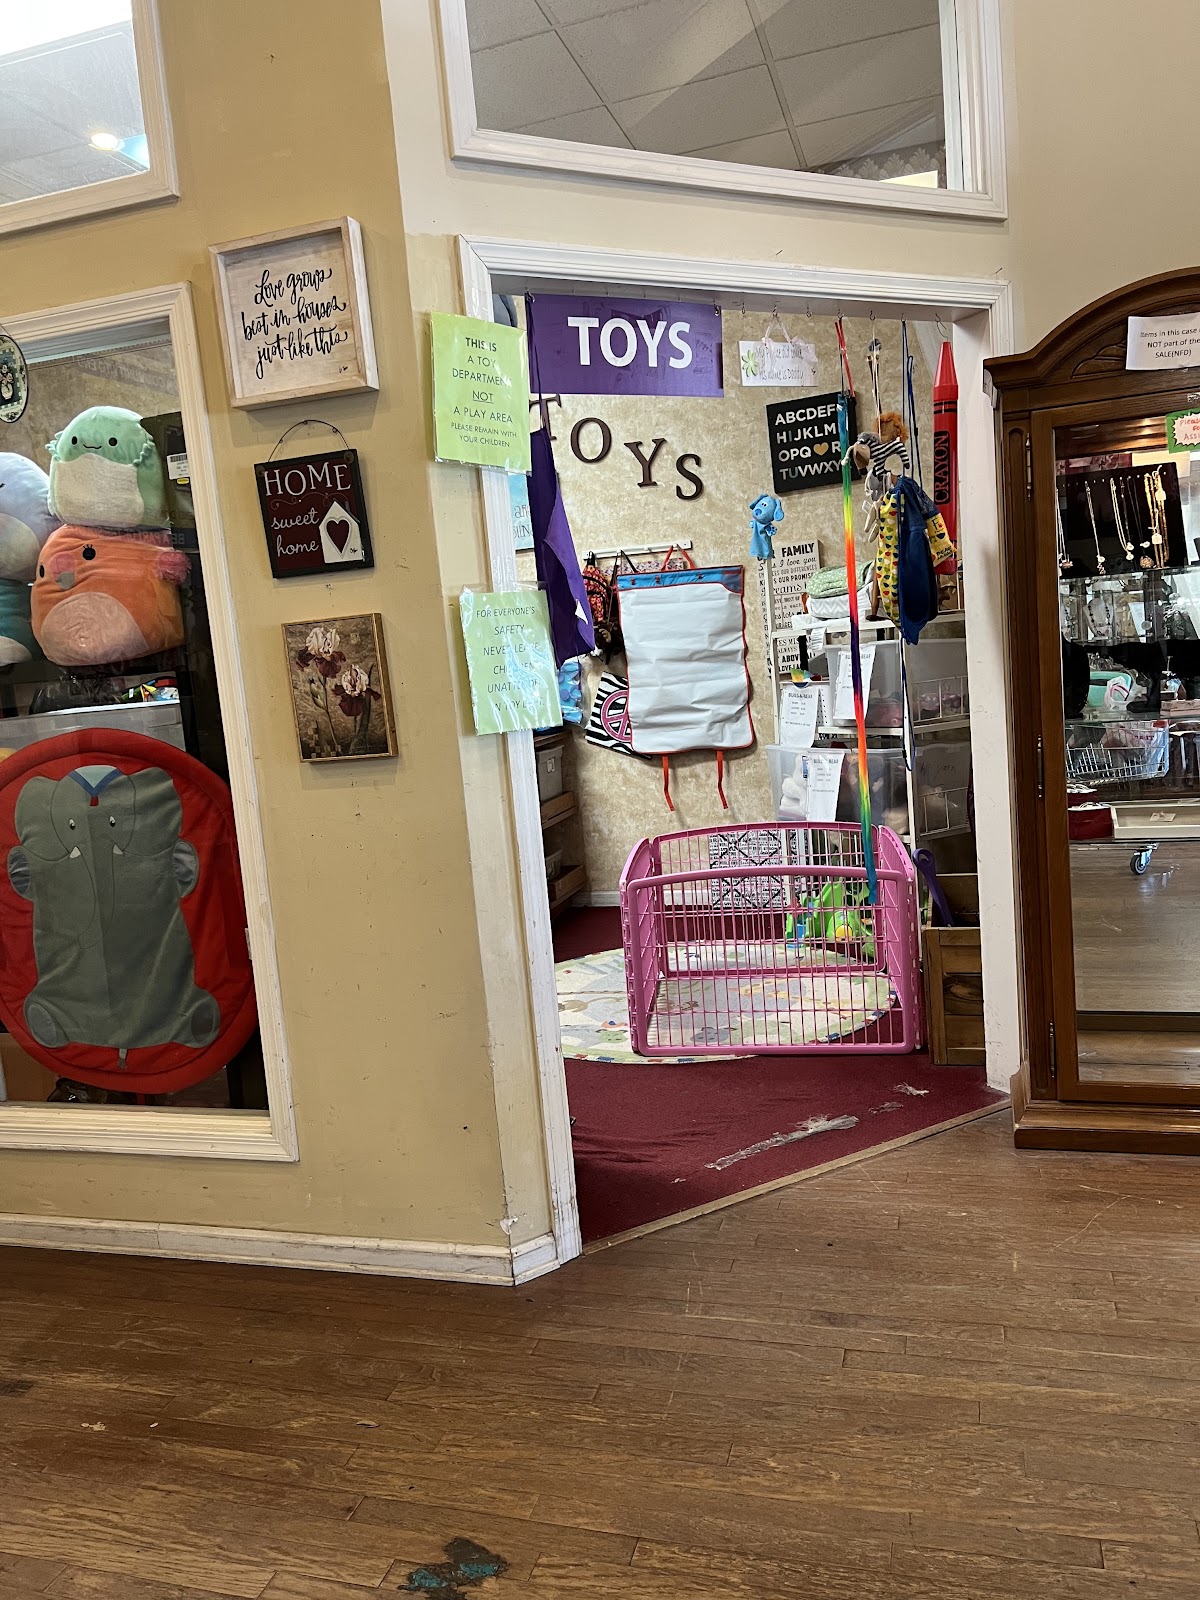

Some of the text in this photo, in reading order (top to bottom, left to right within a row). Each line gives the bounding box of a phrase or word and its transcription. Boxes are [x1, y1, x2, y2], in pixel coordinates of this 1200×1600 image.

[254, 268, 333, 308] Love grows
[241, 295, 347, 341] best in houses
[465, 337, 497, 352] THIS IS
[567, 316, 693, 369] TOYS
[1163, 340, 1178, 348] part
[1179, 338, 1188, 346] of
[255, 323, 348, 380] just like this
[1155, 349, 1192, 358] SALE(NFD)
[467, 355, 496, 369] A TOY
[452, 368, 513, 387] DEPARTMEN
[472, 390, 494, 402] NOT
[453, 406, 513, 424] A PLAY AREA
[451, 422, 517, 438] PLEASE REMAIN WITH
[459, 435, 510, 448] YOUR CHILDREN
[529, 394, 704, 501] TOYS
[934, 433, 949, 504] CRAYON
[264, 461, 351, 497] HOME
[271, 507, 320, 530] sweet
[276, 535, 320, 557] home
[781, 543, 815, 557] FAMILY
[803, 557, 816, 565] you
[779, 576, 790, 584] OUR
[476, 606, 536, 618] FOR EVERYONE'S
[494, 624, 525, 636] SAFETY
[782, 654, 800, 663] ABOV
